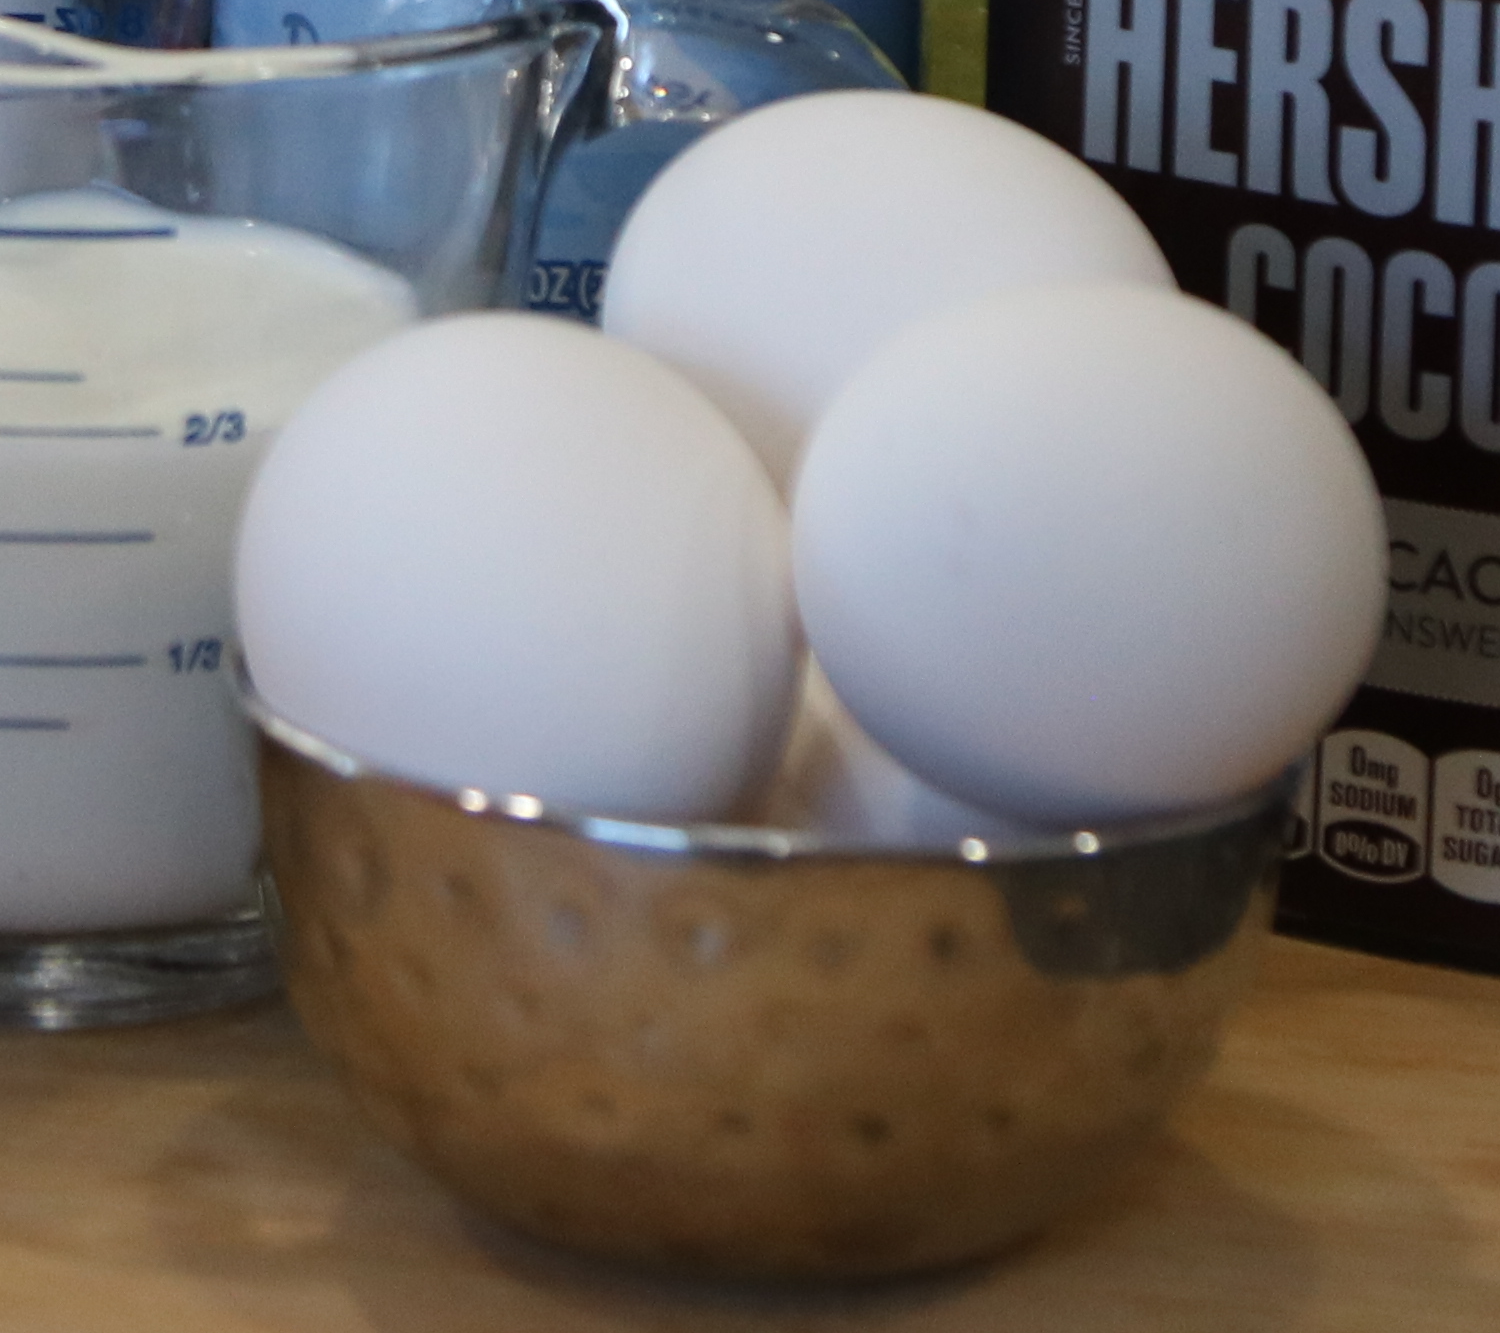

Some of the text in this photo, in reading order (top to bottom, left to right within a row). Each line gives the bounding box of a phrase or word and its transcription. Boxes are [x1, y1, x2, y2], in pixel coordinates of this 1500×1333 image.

[182, 409, 247, 447] 2/3
[168, 637, 223, 675] 1/3
[1330, 781, 1417, 822] SODIUM
